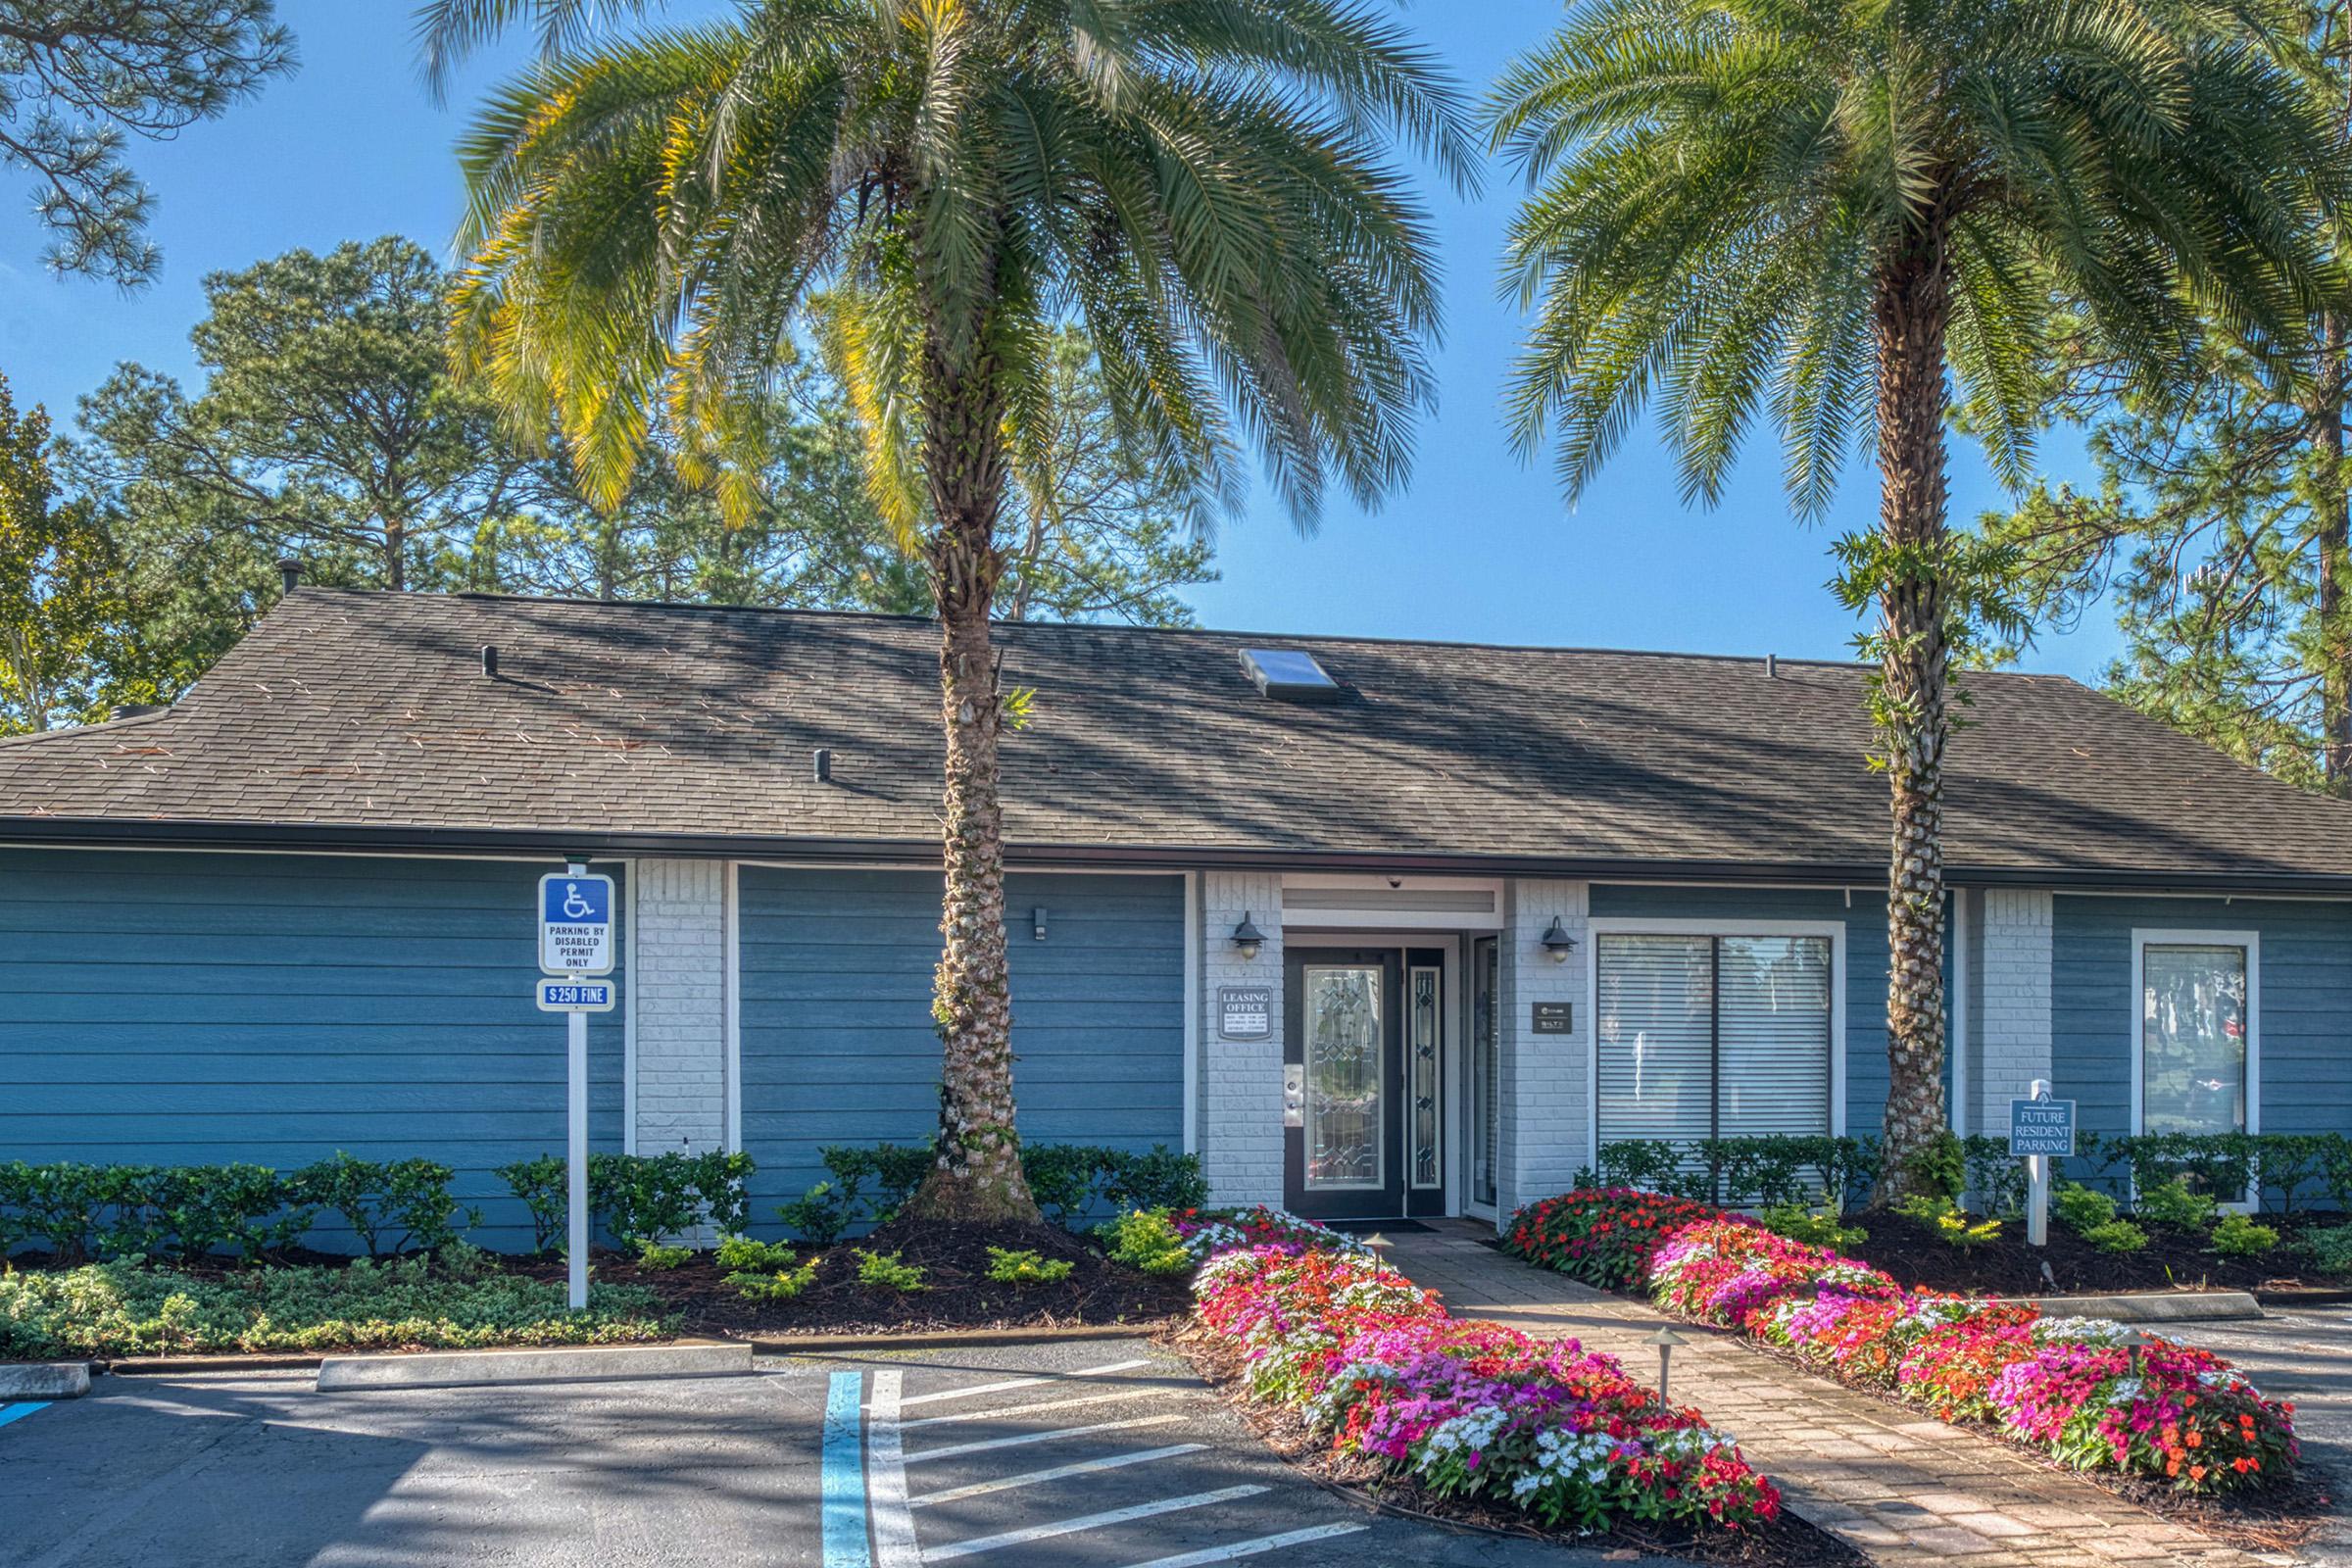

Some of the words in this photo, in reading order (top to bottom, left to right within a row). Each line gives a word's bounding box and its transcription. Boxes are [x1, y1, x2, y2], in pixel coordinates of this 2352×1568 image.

[550, 926, 590, 936] PARKING
[594, 927, 605, 936] BY
[555, 937, 600, 947] DISABLED
[560, 948, 594, 956] PERMIT
[565, 958, 589, 967] ONLY
[581, 987, 604, 1003] FINE
[1223, 993, 1268, 1003] LEASING
[1226, 1003, 1265, 1012] OFFICE
[2021, 1111, 2066, 1123] FUTURE
[2015, 1126, 2071, 1137] RESIDENT
[2017, 1139, 2068, 1152] PARKING
